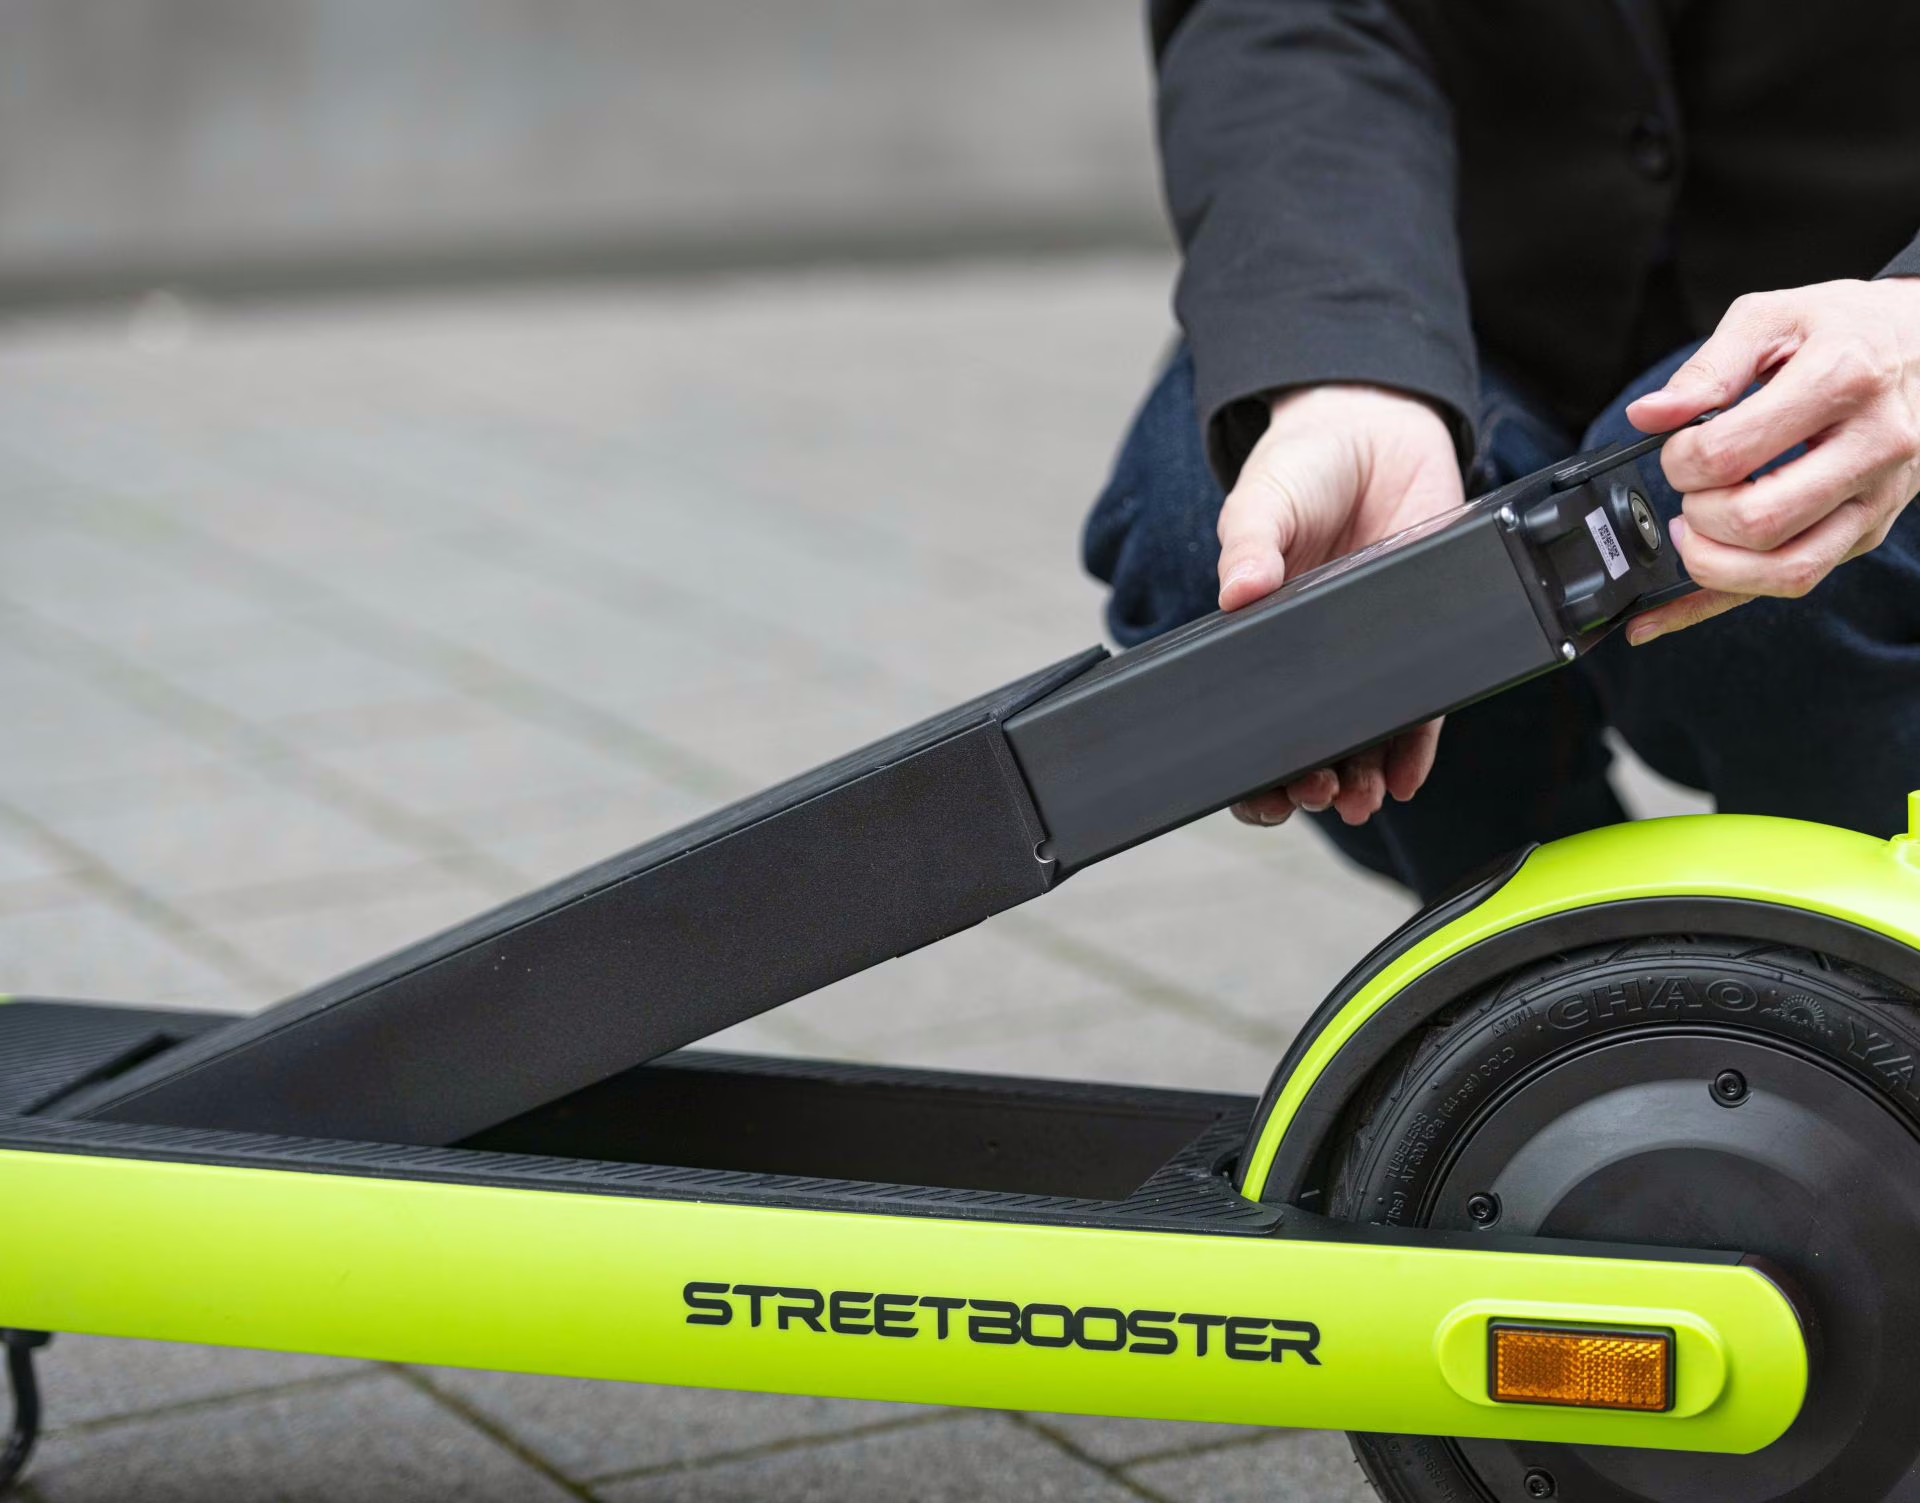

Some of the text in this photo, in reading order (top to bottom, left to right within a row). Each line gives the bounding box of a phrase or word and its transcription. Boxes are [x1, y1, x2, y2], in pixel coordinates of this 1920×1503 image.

[1547, 975, 1760, 1030] CHAO
[1479, 1046, 1516, 1077] COLD
[1384, 1111, 1428, 1179] TUBELESS
[683, 1281, 1322, 1366] STREETBOOSTER
